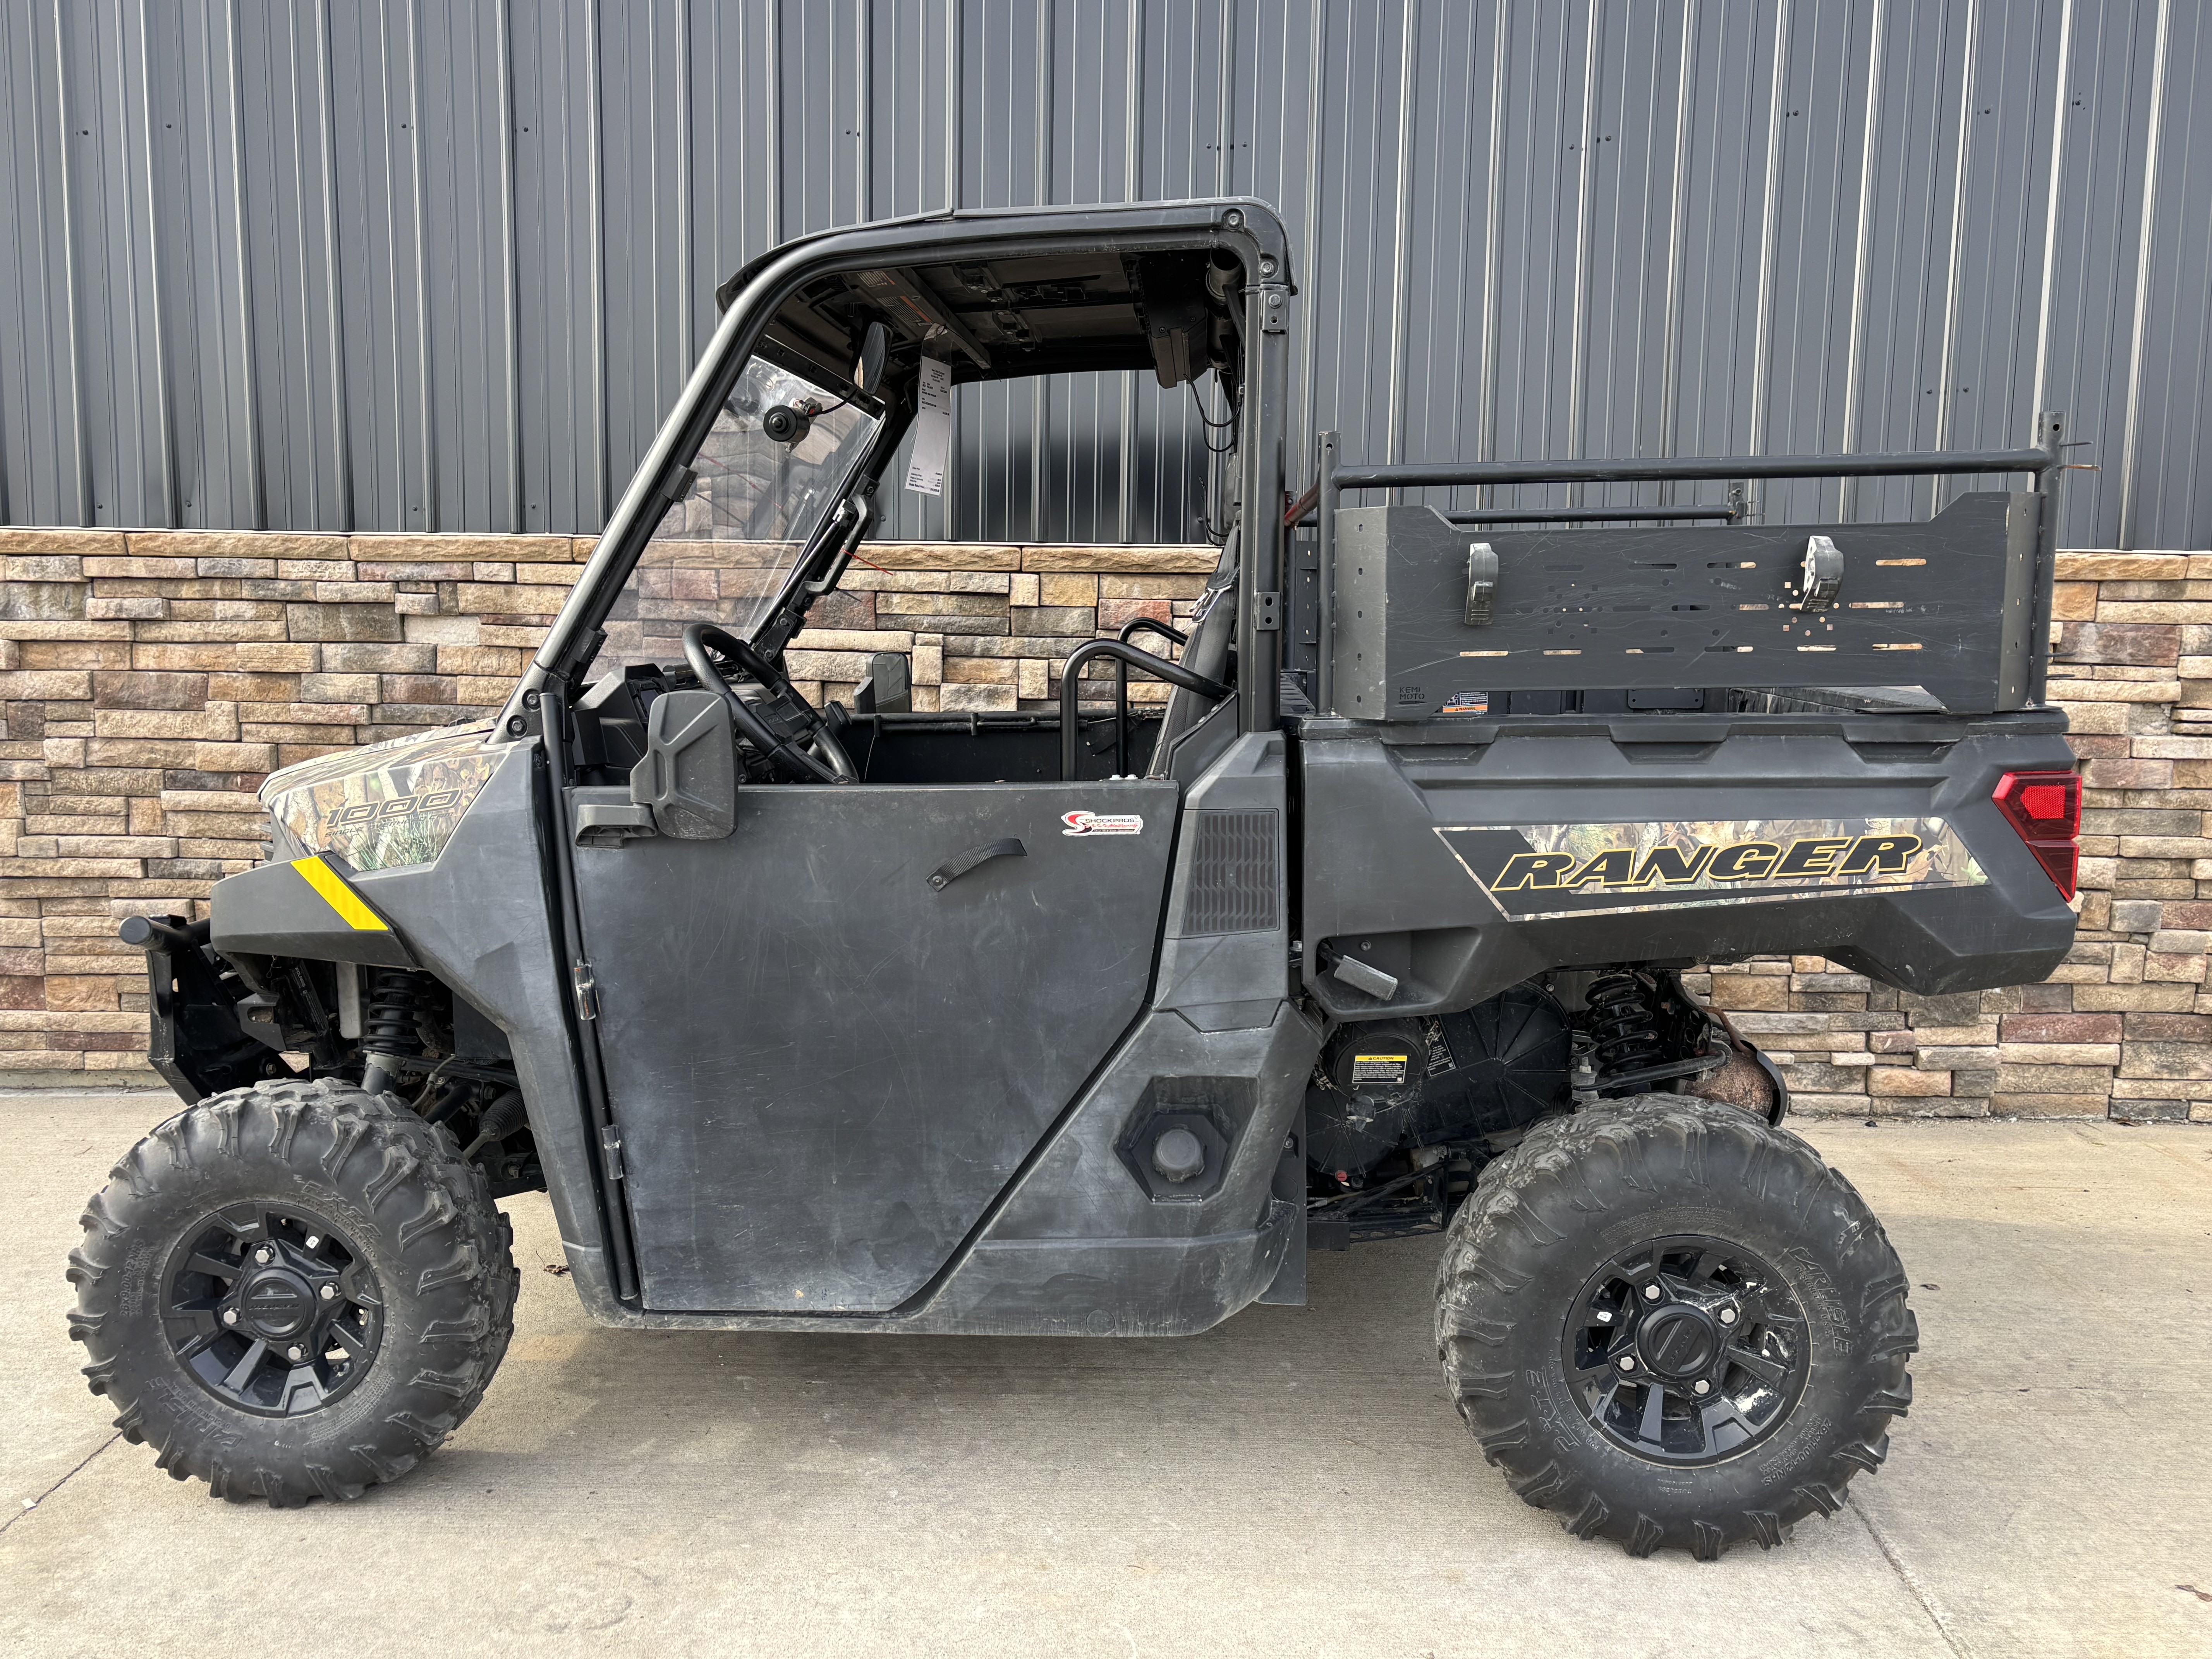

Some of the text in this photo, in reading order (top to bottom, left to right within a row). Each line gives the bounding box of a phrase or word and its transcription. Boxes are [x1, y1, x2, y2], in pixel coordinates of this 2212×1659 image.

[326, 788, 464, 829] 1000
[325, 812, 455, 837] SINGLE OVERHEAD CAM
[1490, 833, 1923, 892] RANGER
[295, 967, 306, 987] POLARIS
[1787, 1246, 1852, 1353] CARLISLE
[1795, 1266, 1819, 1300] DESIGNED
[1816, 1302, 1824, 1311] IN
[187, 1400, 196, 1409] IN
[1555, 1391, 1566, 1407] UTV
[144, 1376, 244, 1449] CARLISLE
[197, 1408, 232, 1430] DESIGNED
[1564, 1409, 1572, 1420] OR
[1571, 1422, 1585, 1436] ATV
[1585, 1437, 1600, 1452] FOR
[1783, 1417, 1833, 1472] 26x11.00-12
